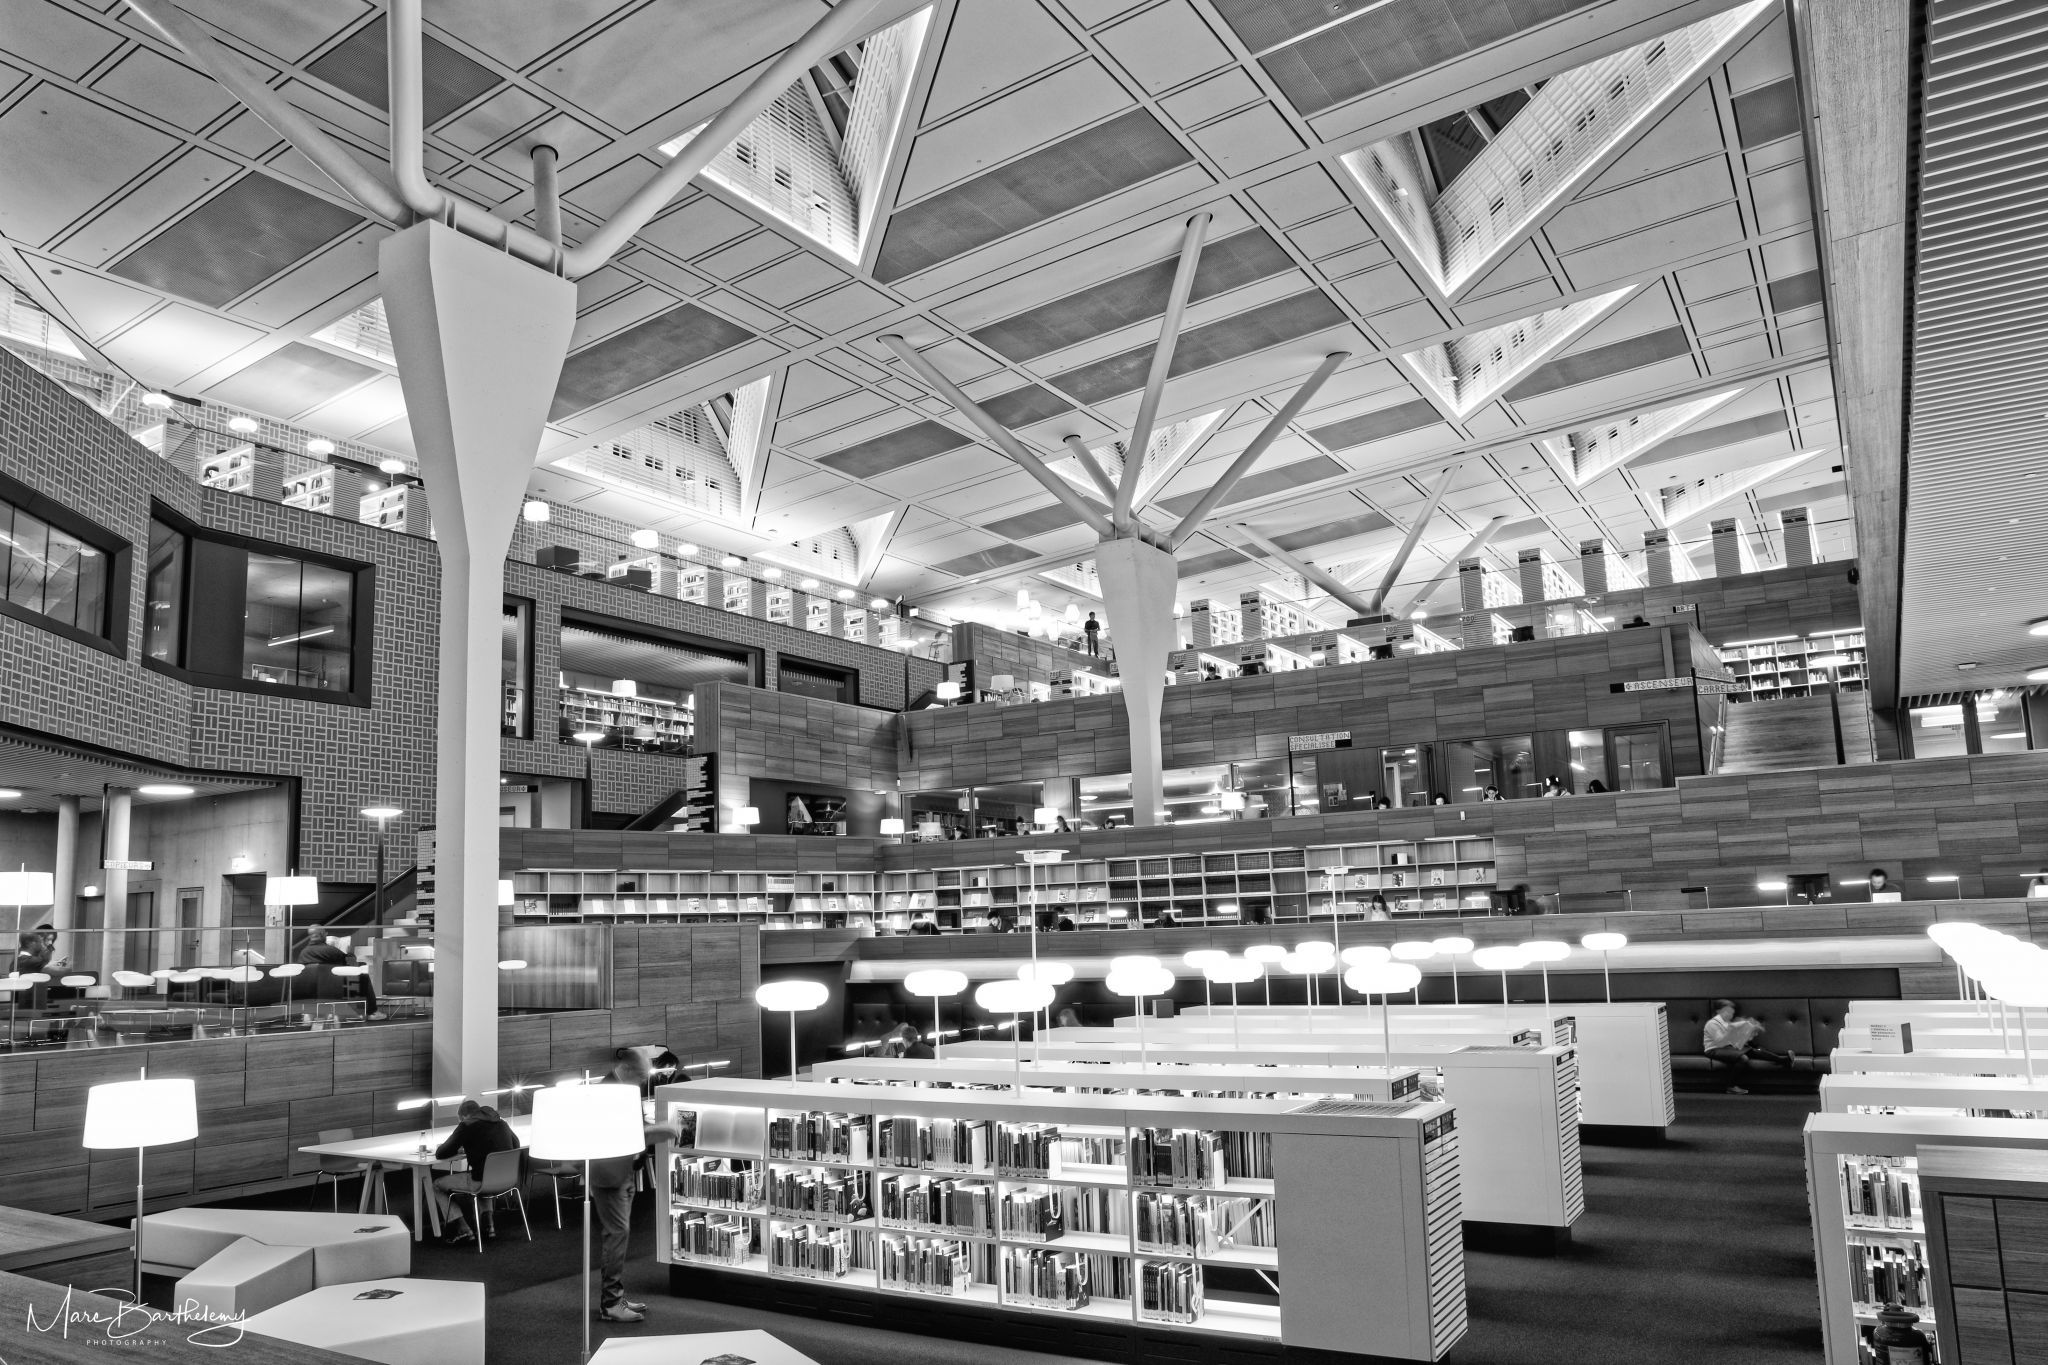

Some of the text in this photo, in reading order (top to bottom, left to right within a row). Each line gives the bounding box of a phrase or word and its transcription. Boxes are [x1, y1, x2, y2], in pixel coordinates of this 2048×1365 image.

[1634, 678, 1693, 689] ASCENSEUR
[1698, 684, 1738, 694] CARRELS
[1289, 732, 1350, 743] CONSULTATION
